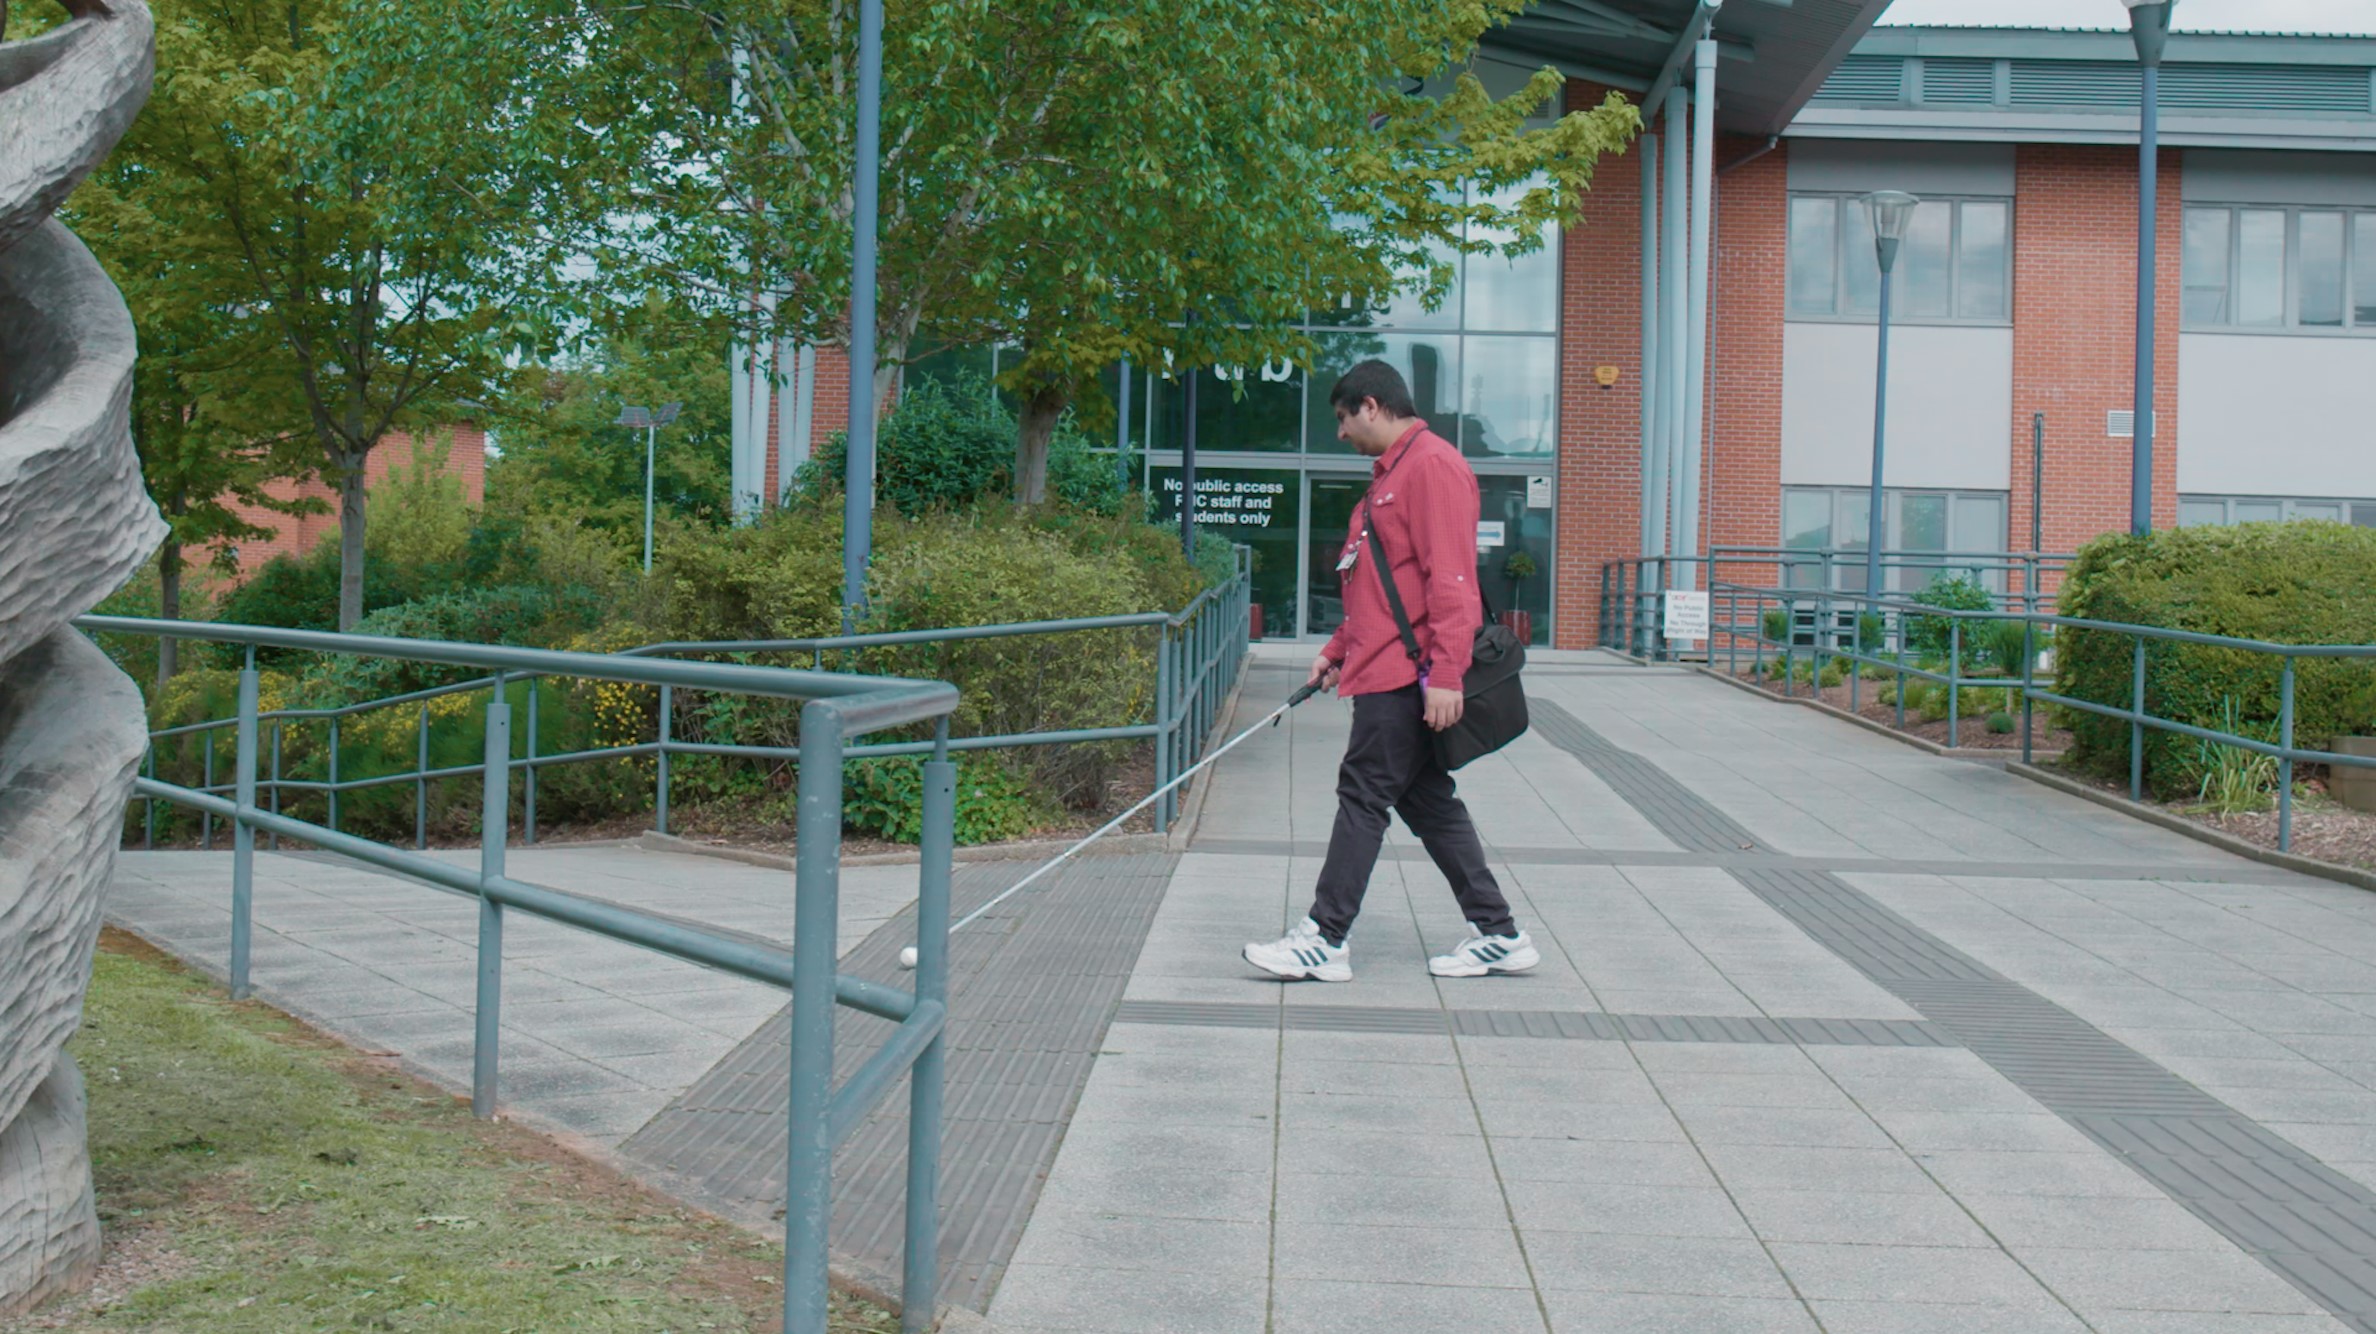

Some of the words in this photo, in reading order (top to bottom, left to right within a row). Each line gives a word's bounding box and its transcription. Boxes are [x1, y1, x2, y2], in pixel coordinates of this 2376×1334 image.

[1164, 478, 1184, 491] No
[1190, 480, 1231, 493] ublic
[1234, 482, 1283, 494] access
[1210, 495, 1243, 508] staff
[1245, 497, 1272, 509] and
[1175, 511, 1236, 523] sdents
[1240, 512, 1270, 527] only
